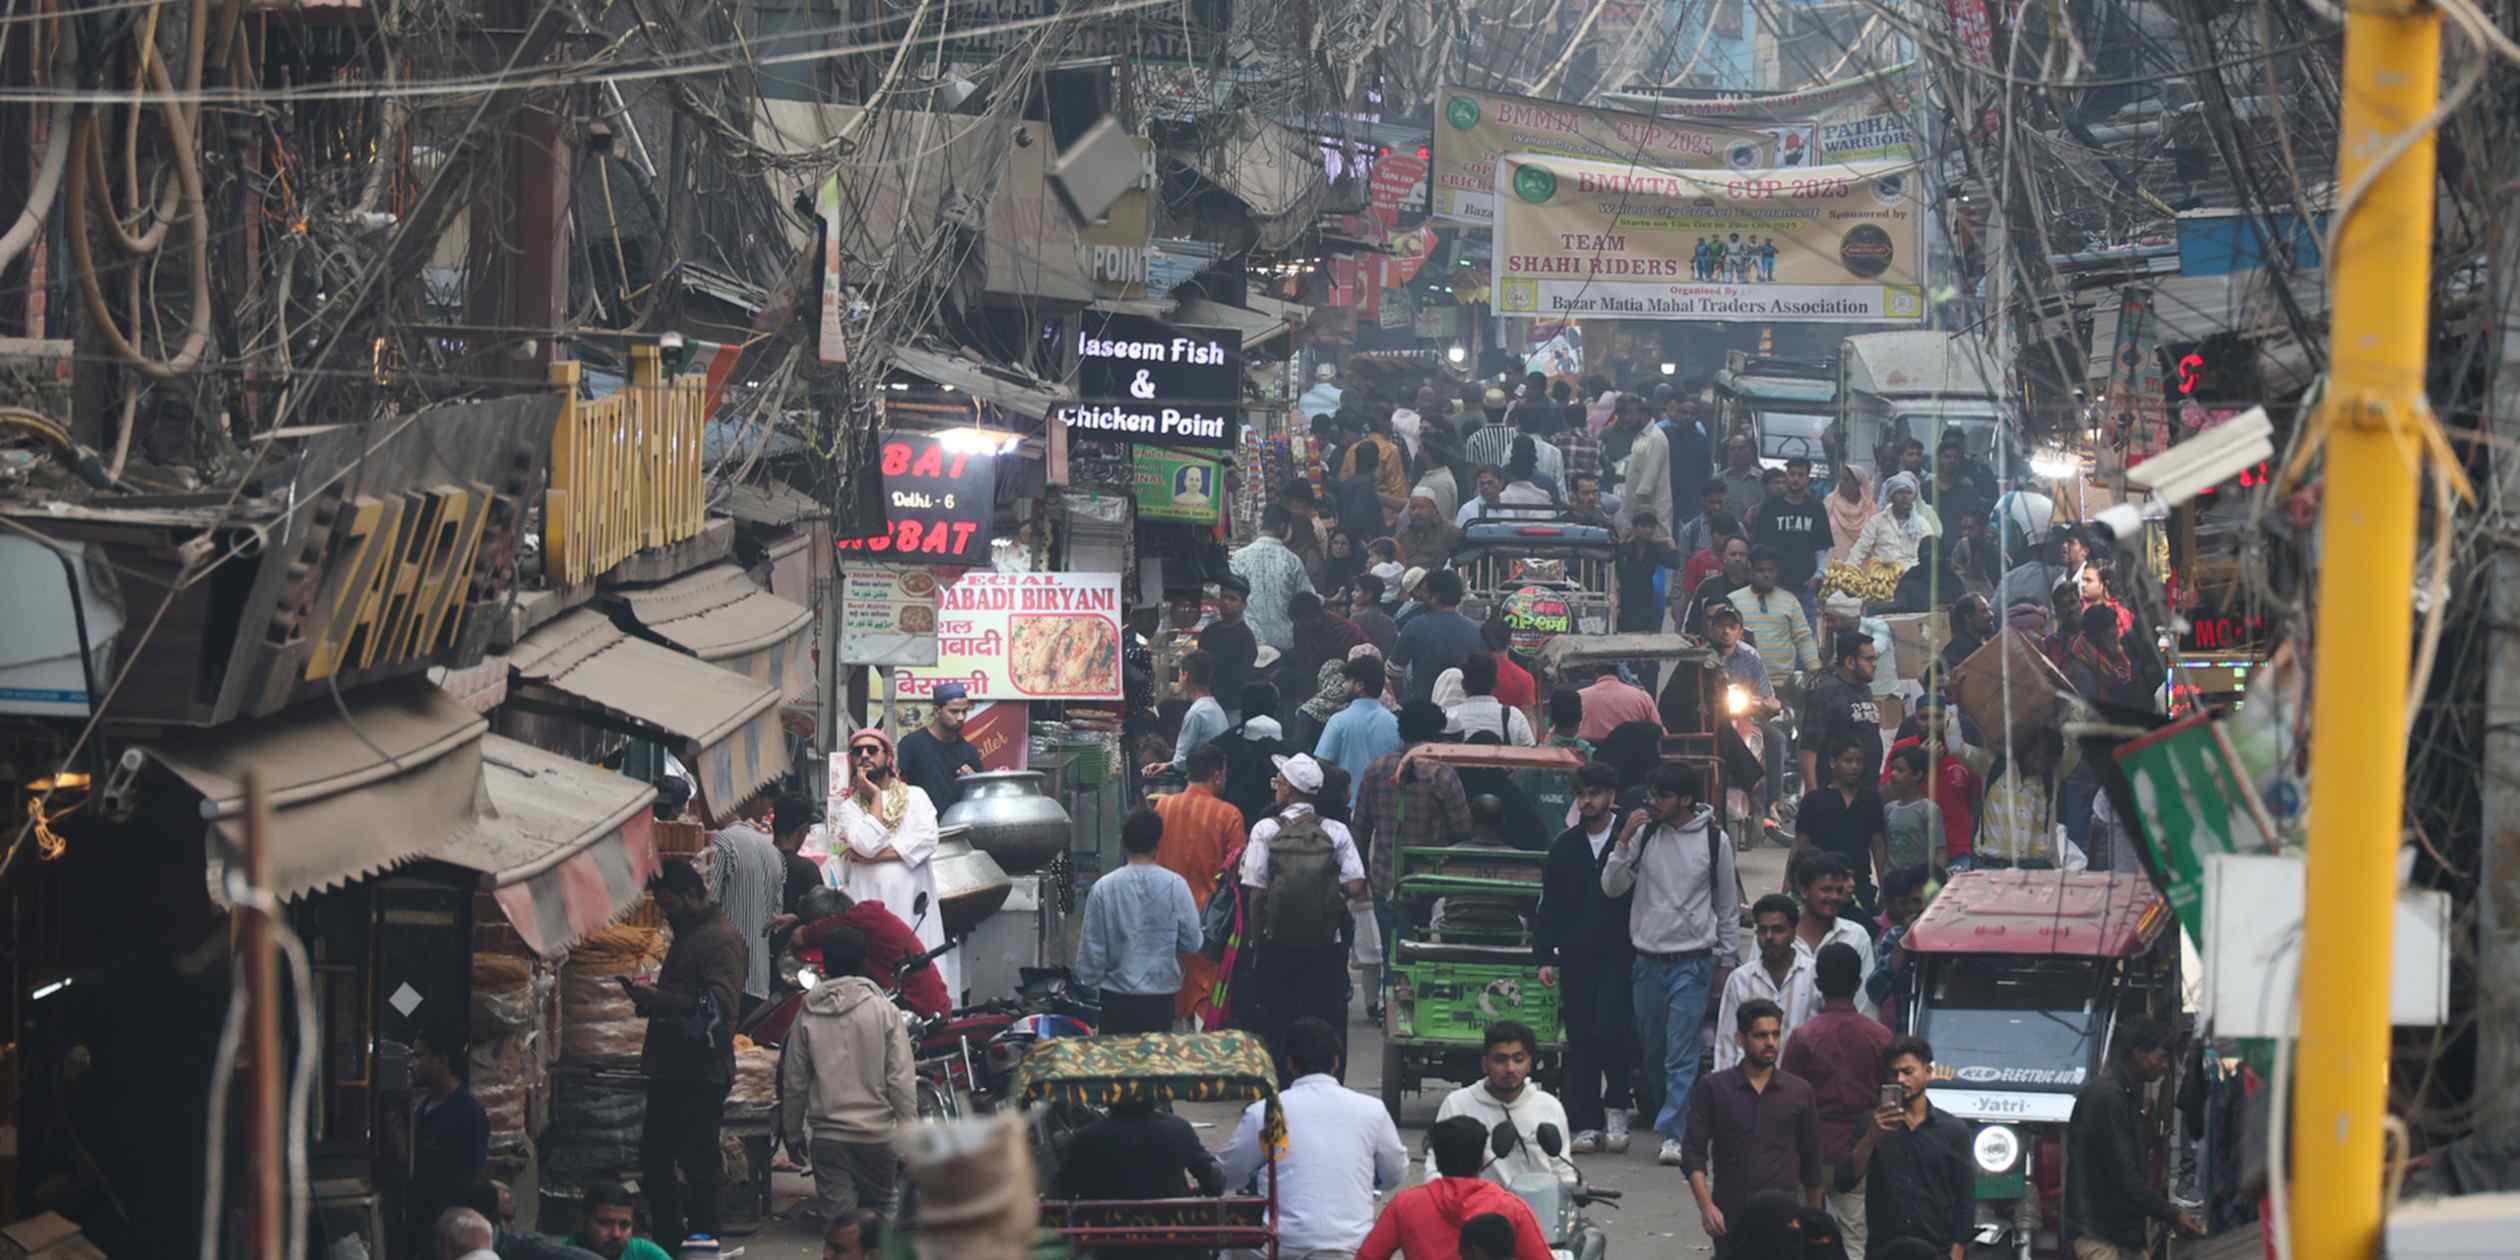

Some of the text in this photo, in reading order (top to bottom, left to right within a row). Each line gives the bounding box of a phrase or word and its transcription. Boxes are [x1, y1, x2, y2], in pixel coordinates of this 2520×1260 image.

[1497, 102, 1580, 134] BMMTA
[1616, 121, 1661, 146] CUP
[1578, 172, 1850, 200] BMMTA CUP 2025
[1829, 209, 1907, 221] Sponsored by
[1561, 233, 1626, 252] TEAM
[1092, 245, 1151, 283] POINT
[1509, 255, 1678, 276] SHAHI RIDERS
[1669, 286, 1722, 297] Organised
[1552, 295, 1869, 315] Bazar Matia Mahal Traders Association
[1171, 337, 1225, 366] Fish
[1130, 368, 1156, 399] &
[1058, 404, 1225, 438] Chicken Point
[891, 491, 933, 508] Delhi
[944, 493, 956, 509] 6
[959, 575, 1063, 586] ECIAL
[1022, 587, 1115, 611] BIRYANI
[2000, 1067, 2053, 1085] ELECTRIC
[1978, 1098, 2025, 1112] Yatri
